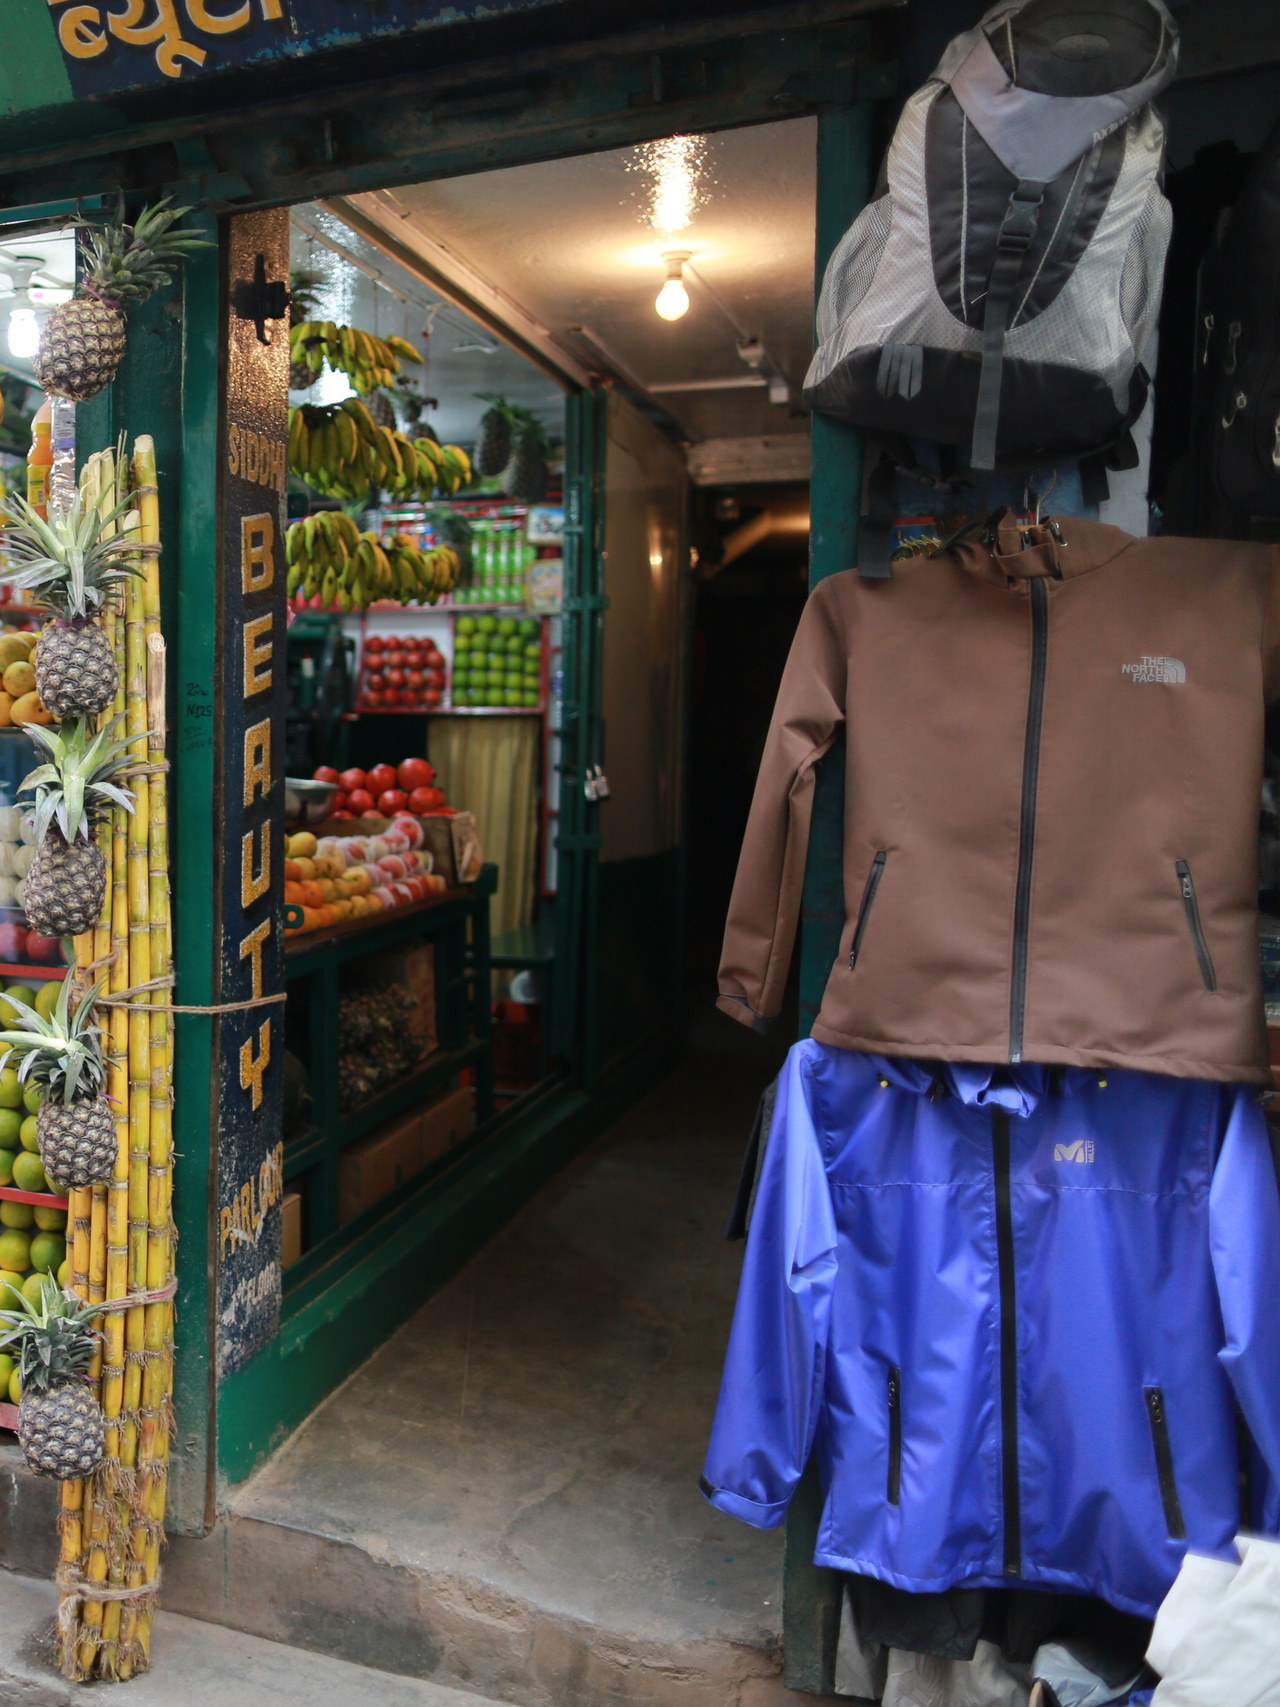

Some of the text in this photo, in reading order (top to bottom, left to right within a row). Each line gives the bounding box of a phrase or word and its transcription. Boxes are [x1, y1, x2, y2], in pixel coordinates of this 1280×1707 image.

[1140, 656, 1164, 665] THE
[1122, 664, 1164, 674] NORTH
[1133, 674, 1163, 682] FACE
[240, 511, 276, 1112] BEAUTY
[1087, 1140, 1095, 1163] MILLET
